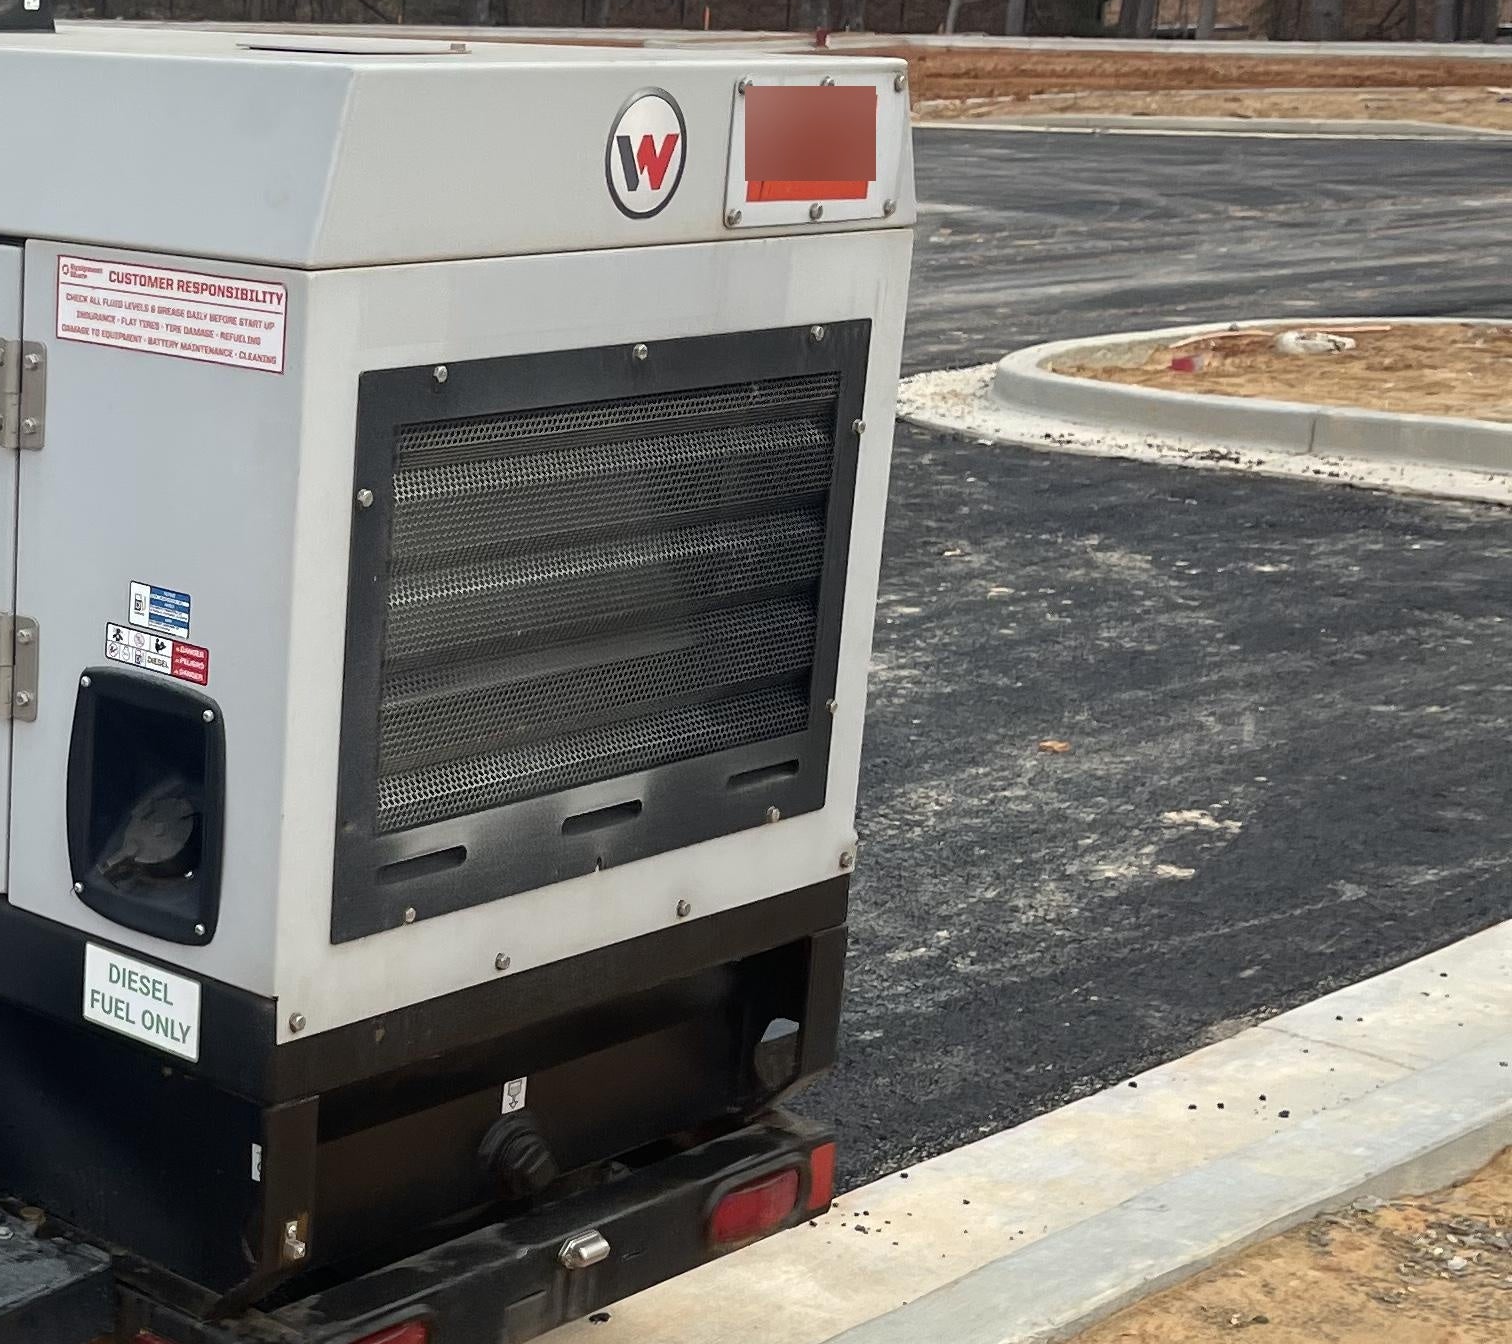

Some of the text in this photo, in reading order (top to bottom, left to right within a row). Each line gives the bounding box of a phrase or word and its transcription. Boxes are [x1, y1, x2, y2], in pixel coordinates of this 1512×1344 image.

[108, 270, 284, 306] CUSTOMER RESPONSIBILITY
[66, 293, 88, 303] CHECK
[90, 296, 101, 306] ALL
[102, 298, 124, 309] FLUID
[124, 301, 149, 313] LEVELS
[157, 306, 185, 317] GREASE
[186, 310, 208, 321] DAILY
[209, 313, 238, 326] BEFORE
[239, 317, 263, 329] START
[264, 321, 276, 330] UP
[120, 316, 137, 327] FLAT
[139, 319, 160, 331] TIRES
[165, 322, 182, 334] TIRE
[184, 326, 215, 339] DAMAGE
[220, 331, 261, 346] REFUELING
[62, 323, 277, 365] DAMAGE TO EQUIPMENT BATTERY MAINTENANCE CLEANING
[108, 962, 174, 1006] DIESEL
[90, 988, 192, 1045] FUEL ONLY
